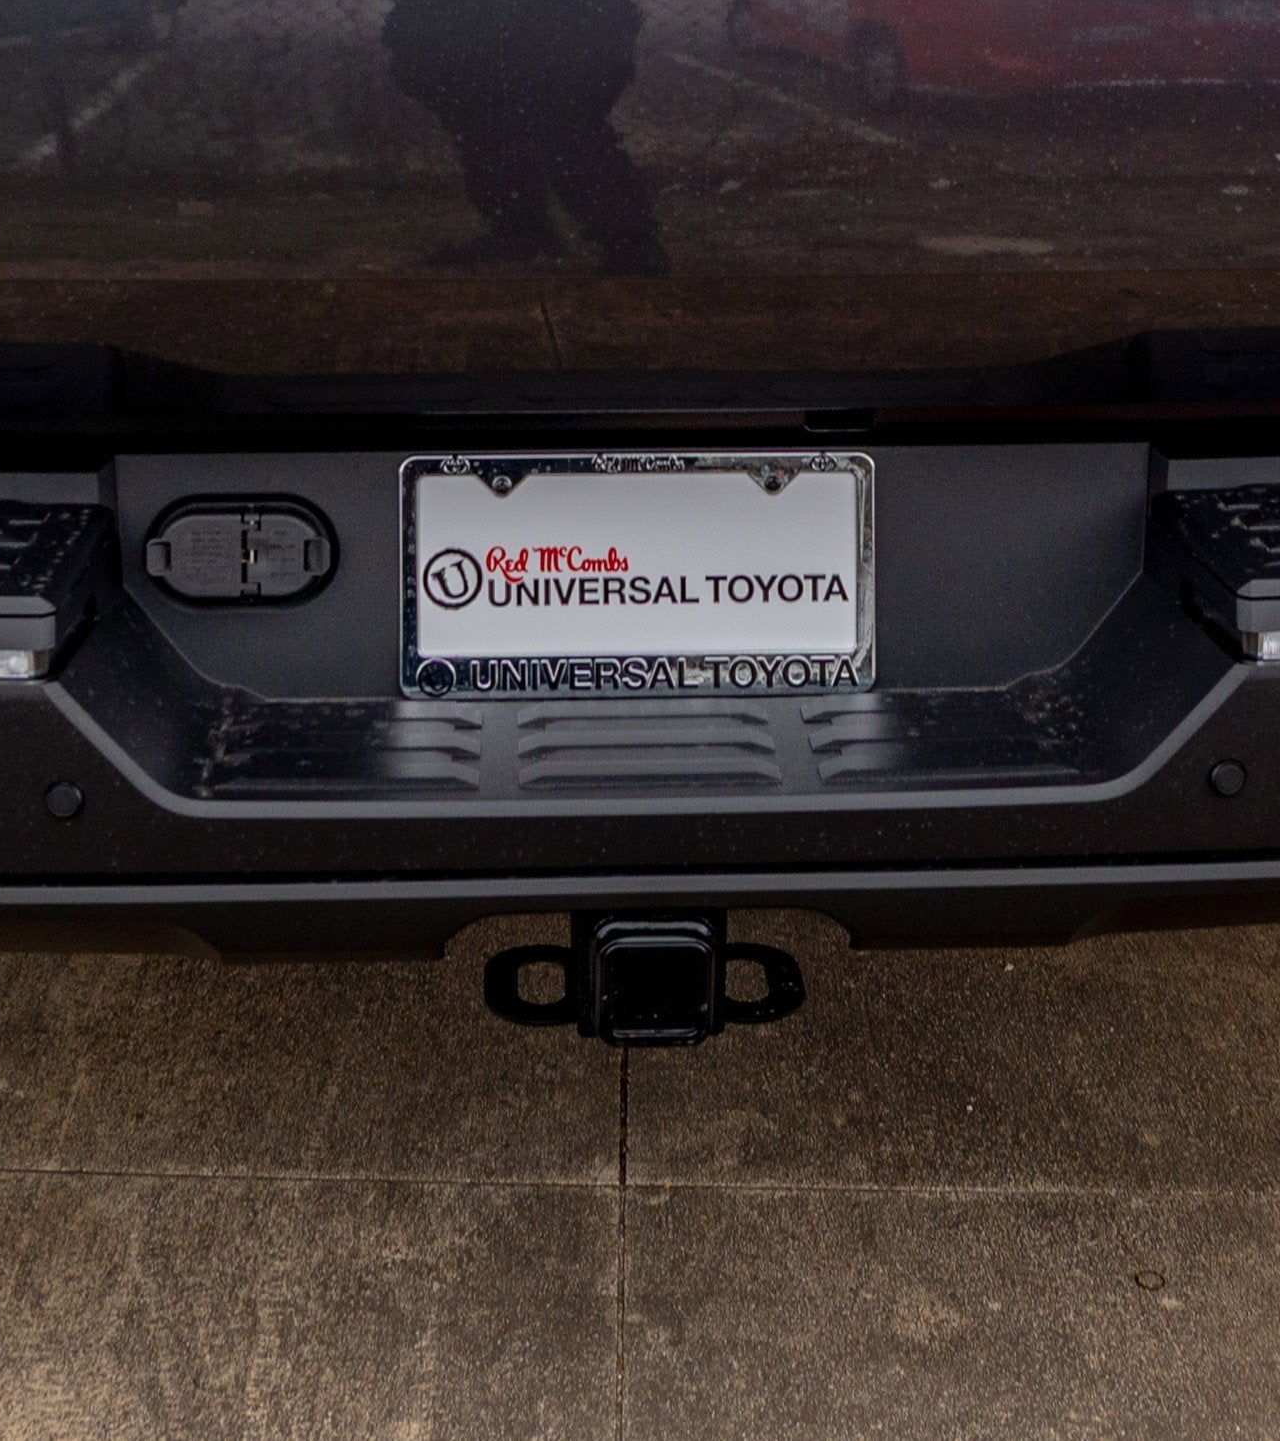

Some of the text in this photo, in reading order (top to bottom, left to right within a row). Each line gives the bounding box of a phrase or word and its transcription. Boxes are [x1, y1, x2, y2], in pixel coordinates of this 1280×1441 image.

[486, 545, 629, 583] Red McCombs
[487, 574, 849, 607] UNIVERSAL TOYOTA
[470, 656, 860, 692] UNIVERSAL TOYOTA
